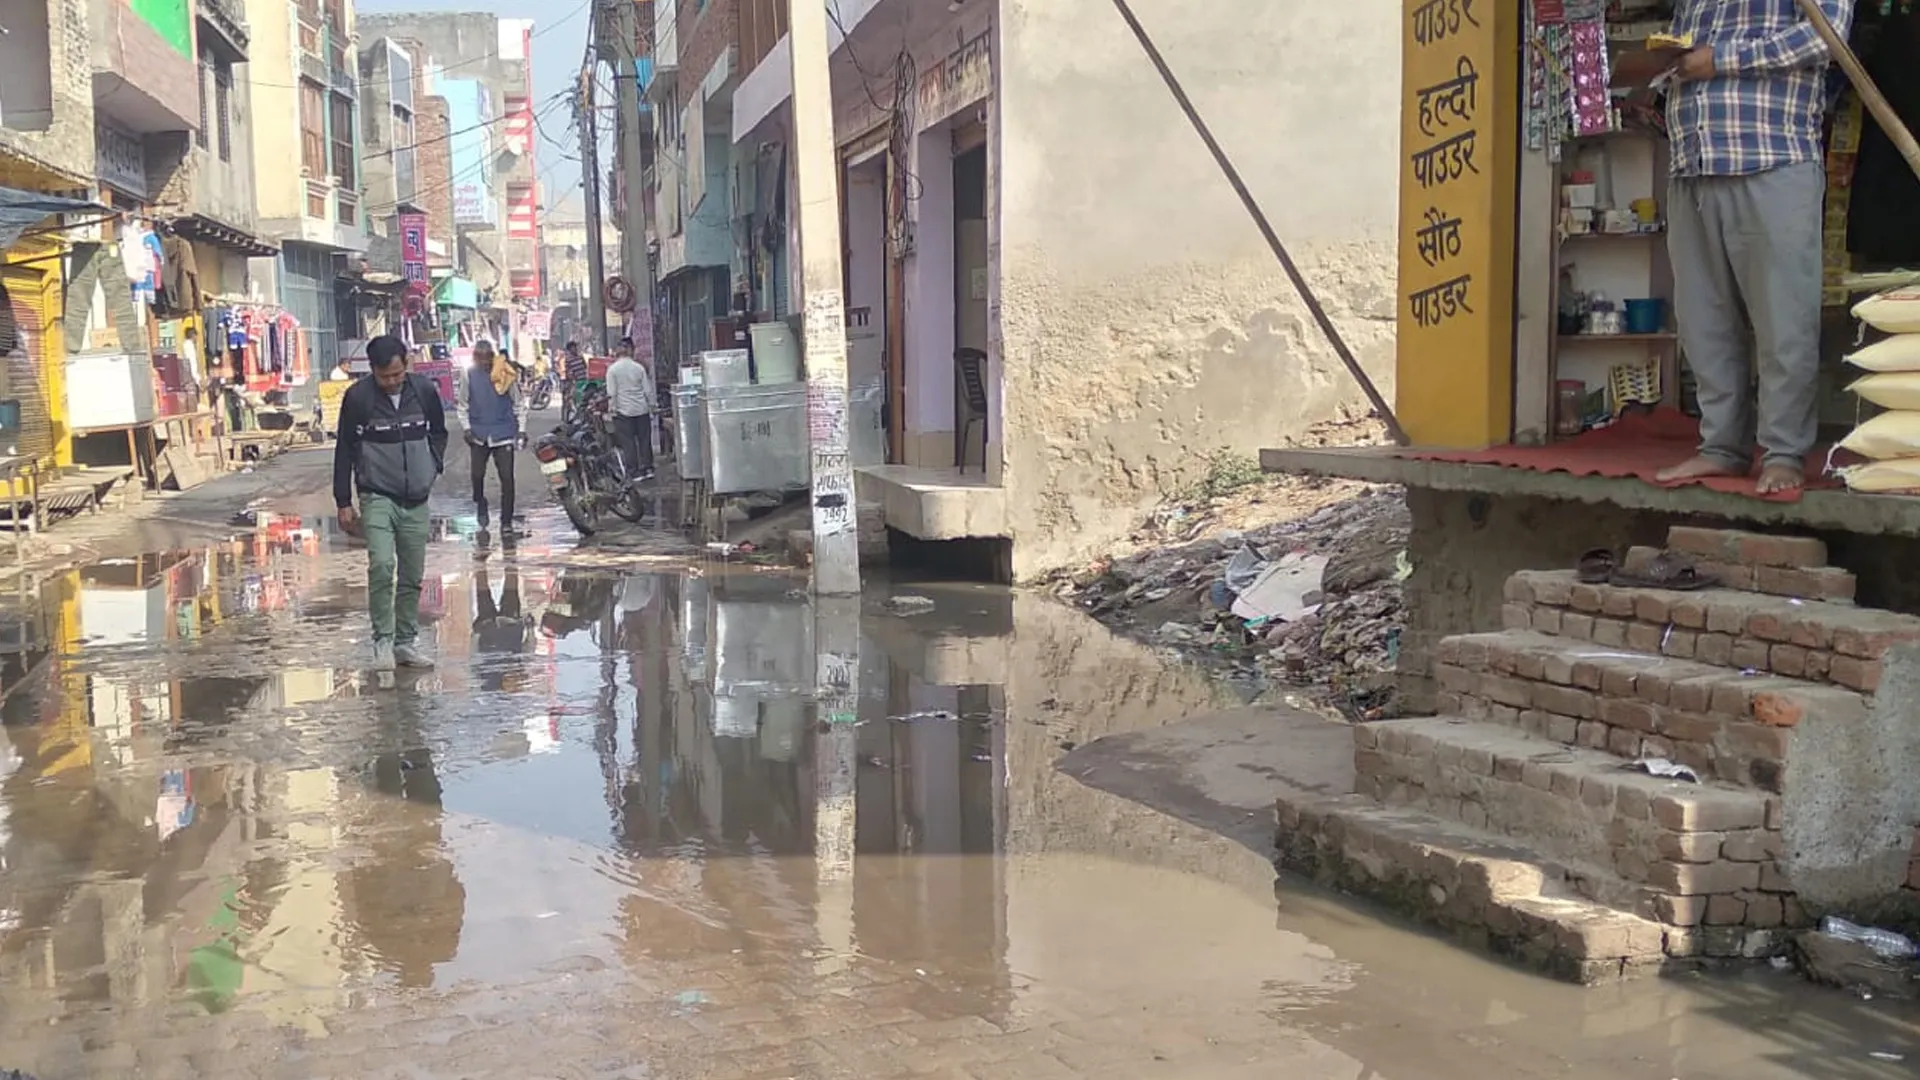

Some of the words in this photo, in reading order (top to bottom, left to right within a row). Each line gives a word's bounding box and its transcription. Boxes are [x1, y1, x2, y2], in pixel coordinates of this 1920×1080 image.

[1416, 55, 1479, 136] हल्दी
[1411, 129, 1479, 189] पाउडर
[1416, 206, 1462, 267] सौंठ
[1408, 274, 1474, 328] पाउडर
